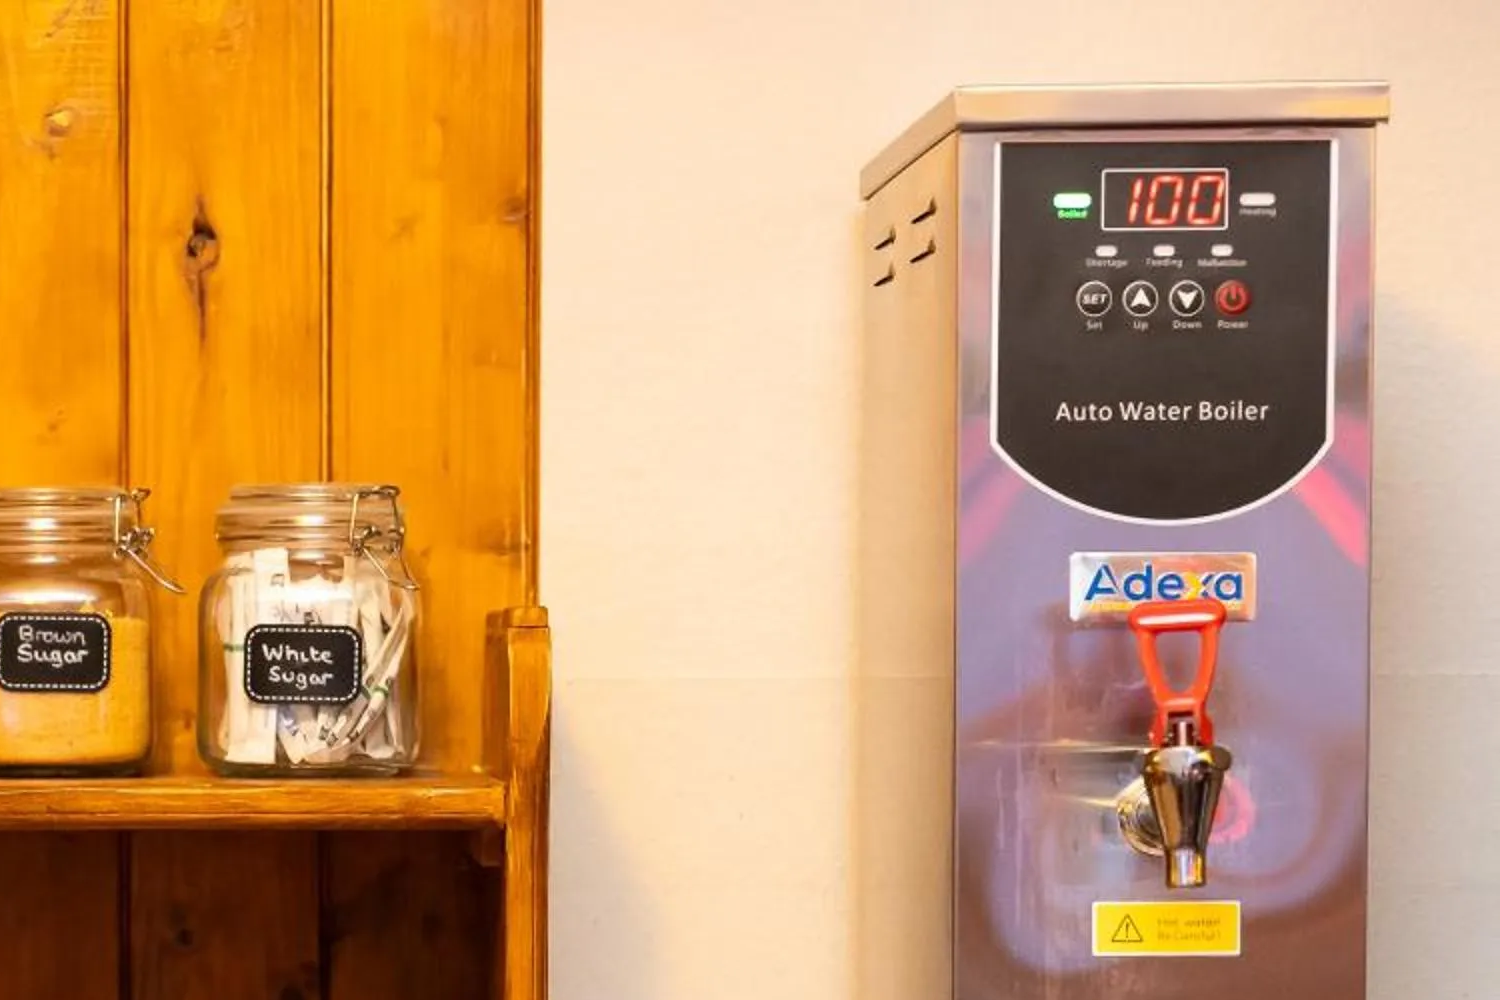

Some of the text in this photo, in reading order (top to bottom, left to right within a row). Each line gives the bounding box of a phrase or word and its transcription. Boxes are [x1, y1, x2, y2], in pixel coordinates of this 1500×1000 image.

[1128, 175, 1225, 225] 100
[1082, 293, 1107, 305] SET
[1086, 320, 1103, 330] Set
[1133, 320, 1149, 331] Up
[1172, 320, 1203, 329] Down
[1217, 320, 1249, 329] Power
[1055, 400, 1270, 421] Auto Water Boiler
[1084, 563, 1243, 601] Adexa
[19, 624, 86, 647] Brown
[16, 644, 89, 669] Sugar
[262, 643, 334, 665] White
[268, 667, 334, 689] Sugar
